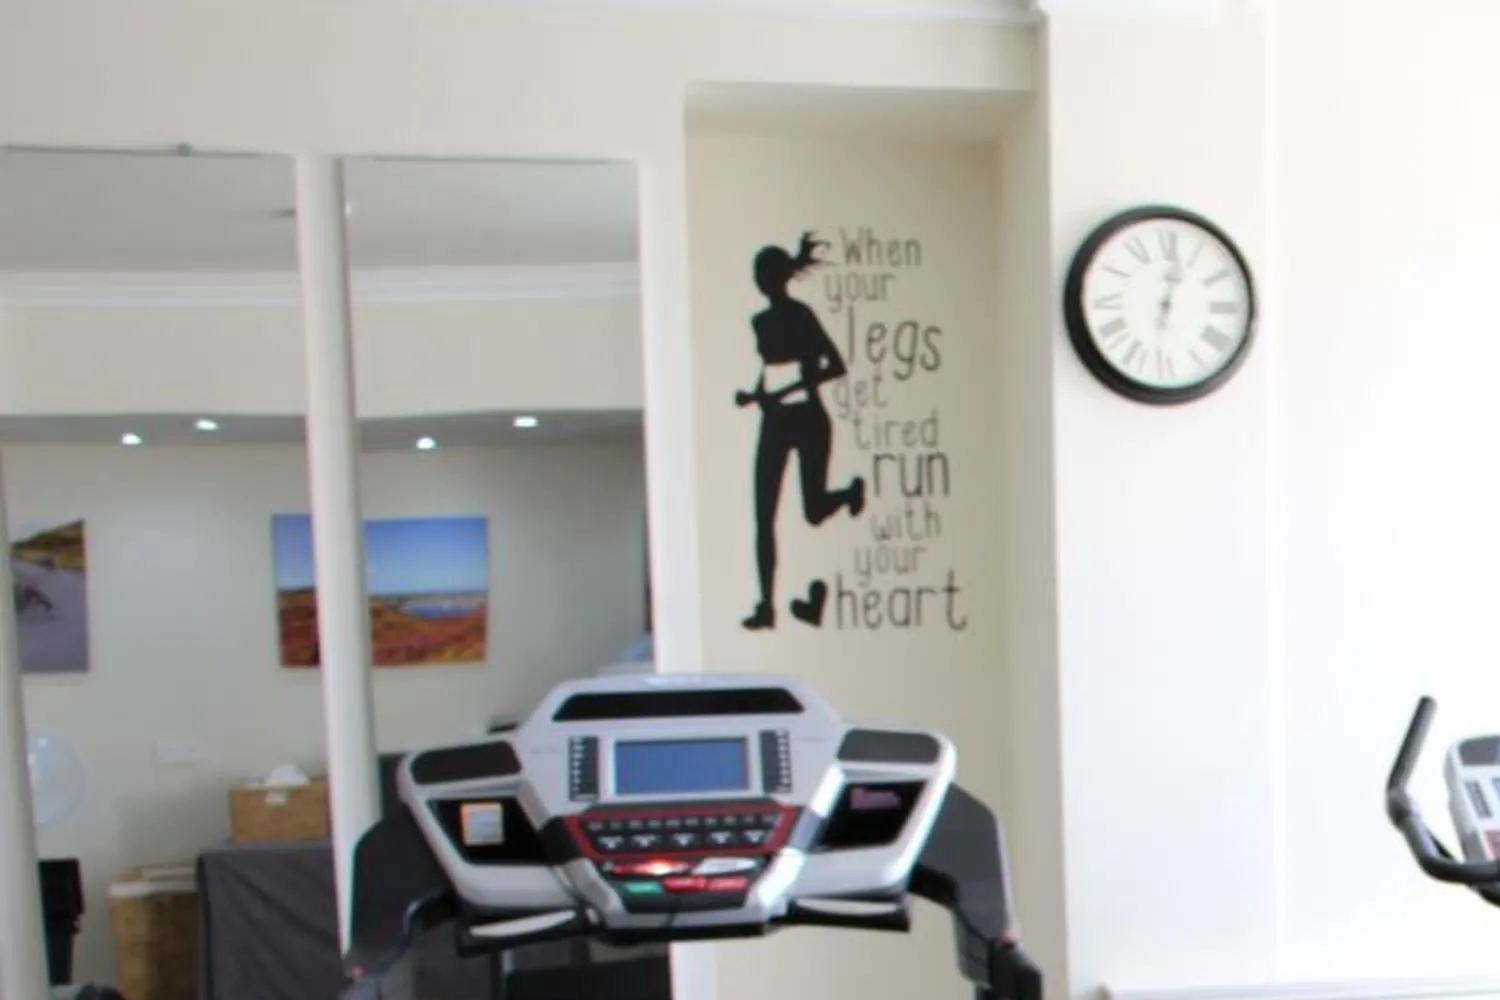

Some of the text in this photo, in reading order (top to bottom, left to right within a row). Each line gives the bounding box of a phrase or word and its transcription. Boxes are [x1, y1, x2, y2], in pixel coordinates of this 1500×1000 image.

[838, 225, 922, 268] When
[823, 272, 896, 314] your
[847, 303, 943, 381] legs
[832, 364, 888, 419] get
[853, 408, 940, 450] tired
[873, 452, 951, 498] run
[870, 502, 942, 542] with
[854, 545, 928, 588] your
[835, 568, 968, 631] heart
